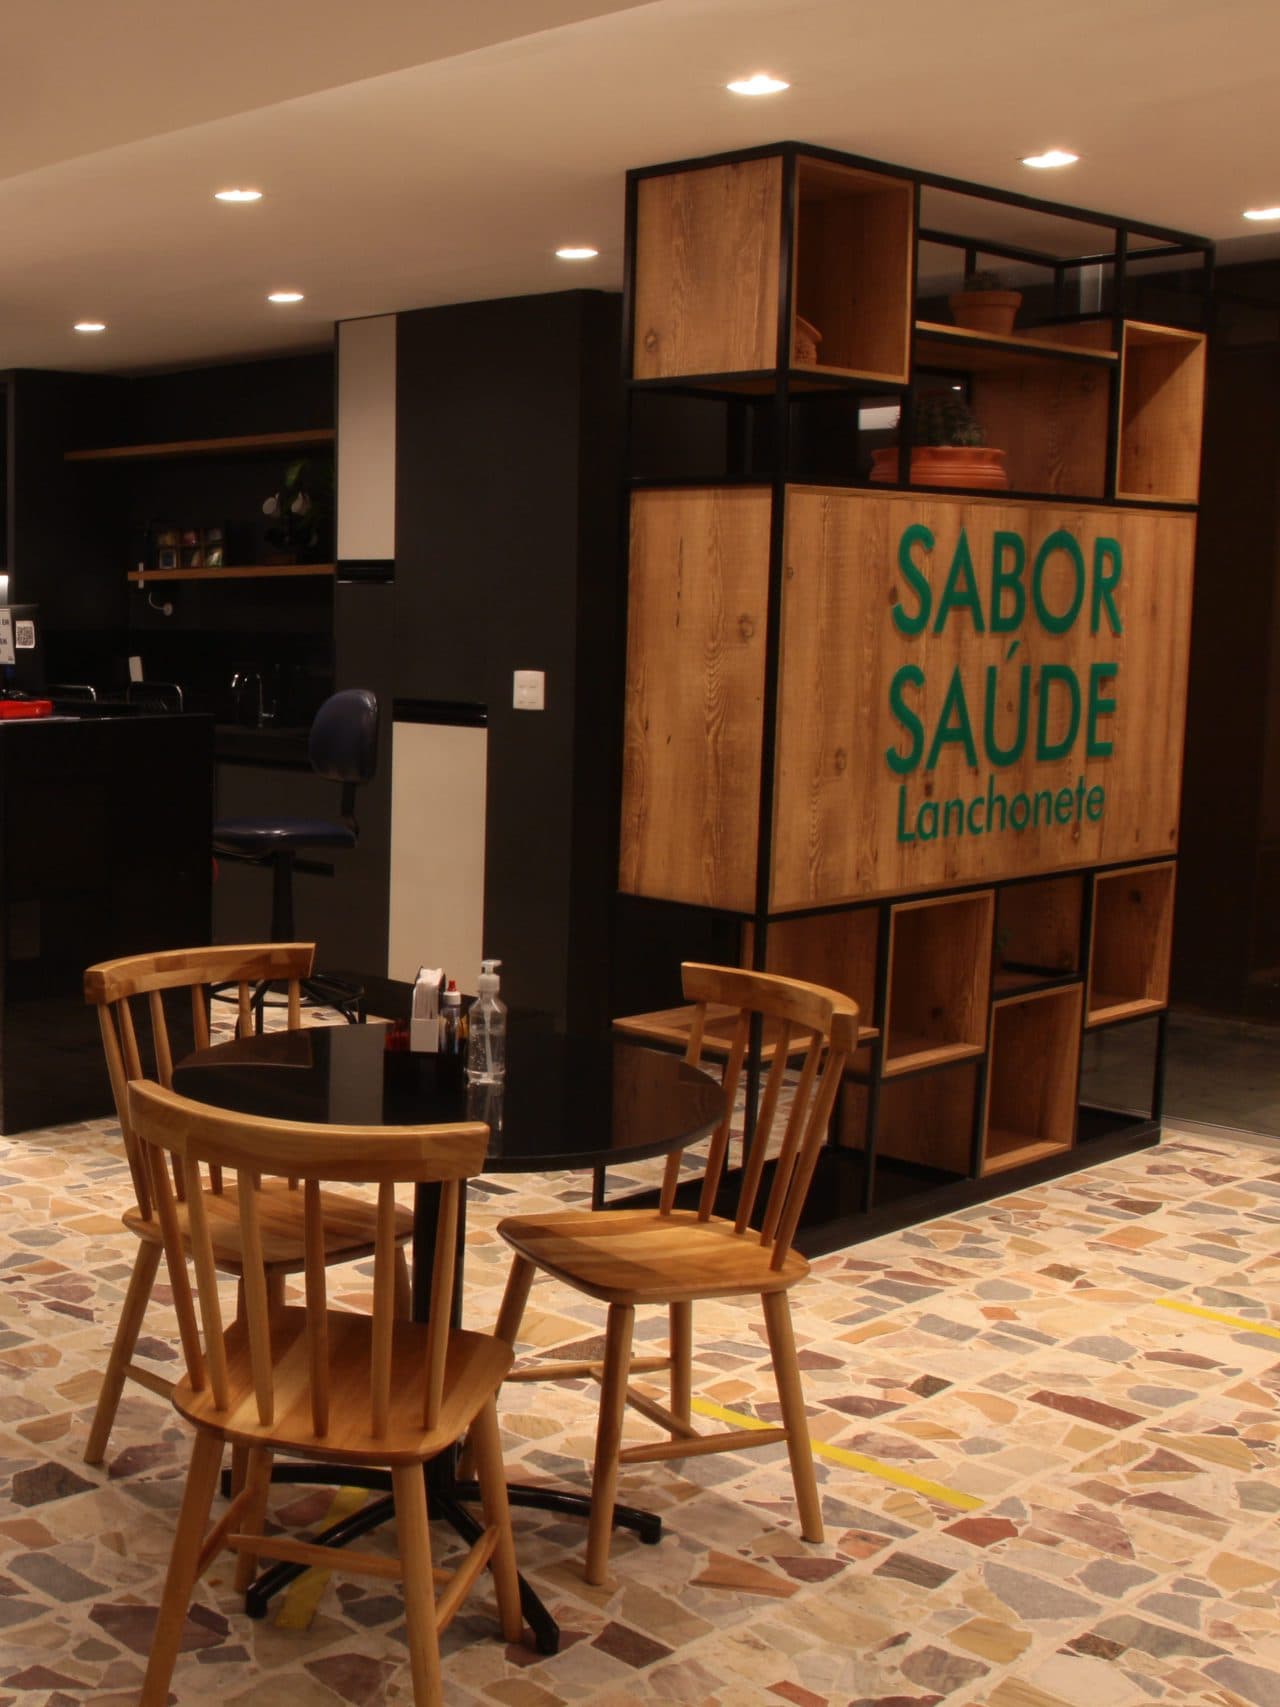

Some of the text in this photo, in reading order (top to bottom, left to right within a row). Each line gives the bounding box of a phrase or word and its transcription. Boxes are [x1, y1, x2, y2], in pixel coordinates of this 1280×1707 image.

[892, 524, 1124, 635] SABOR
[885, 641, 1119, 775] SAÚDE
[897, 773, 1106, 843] Lanchonete
